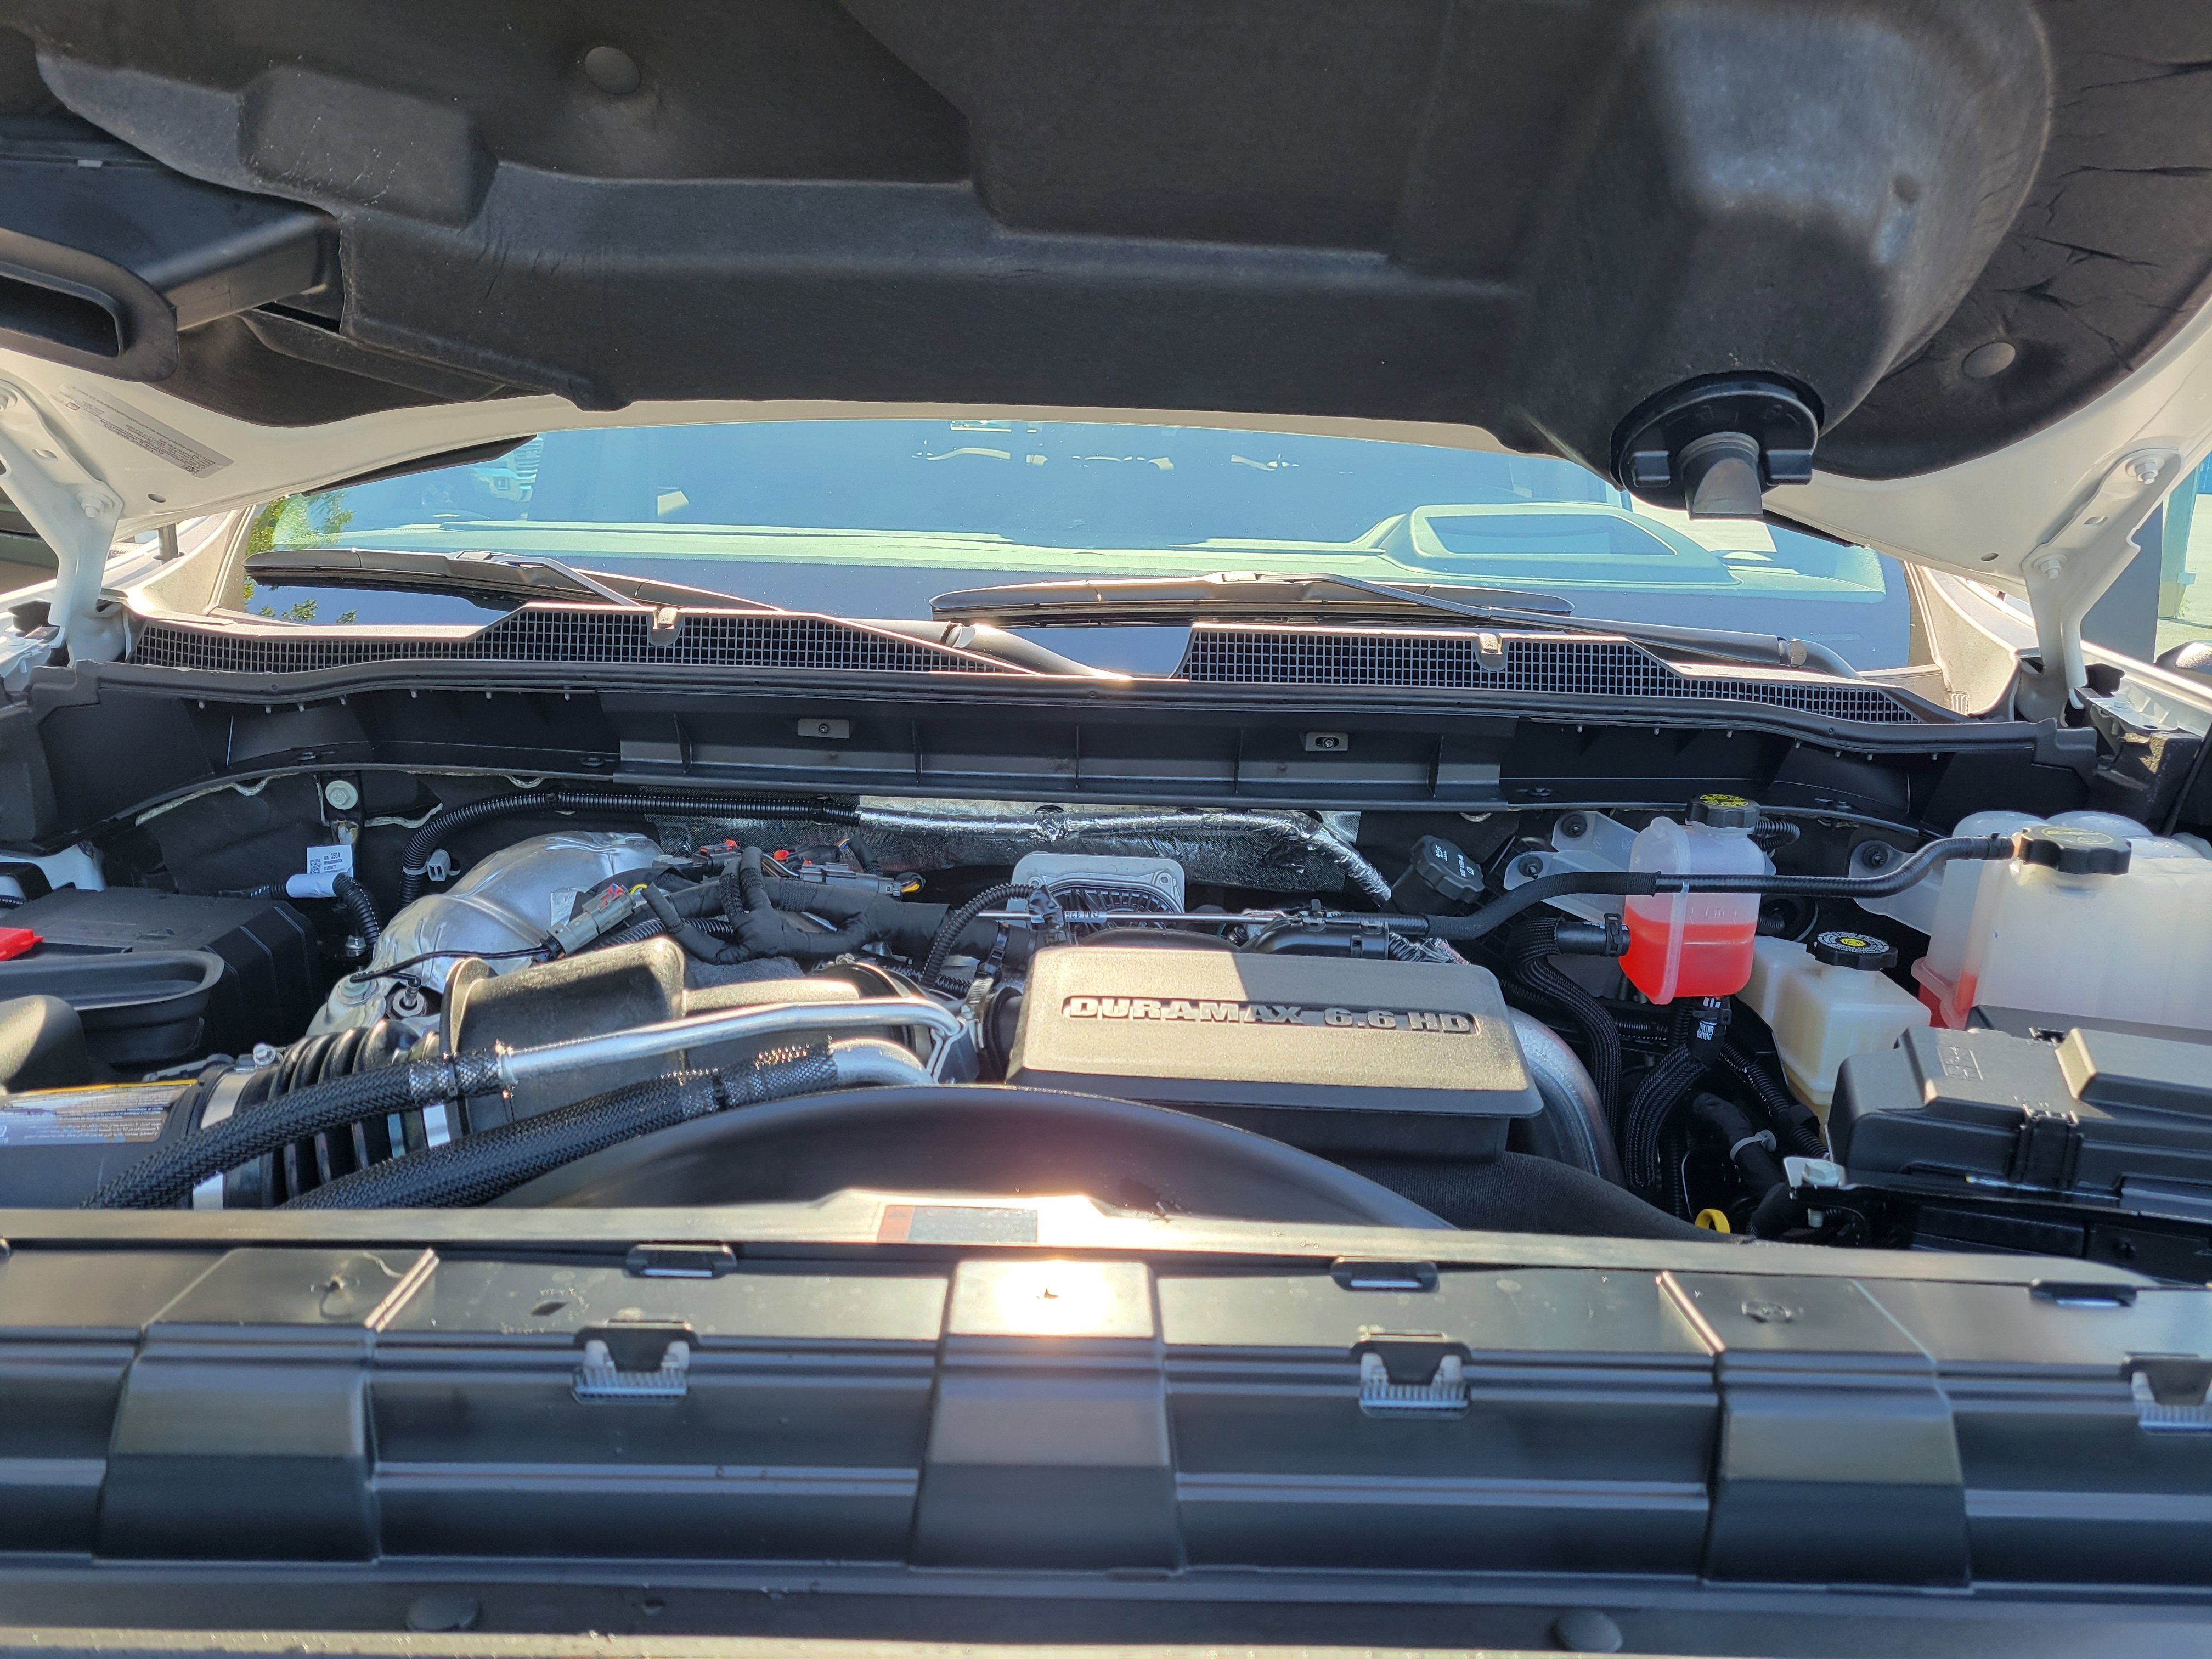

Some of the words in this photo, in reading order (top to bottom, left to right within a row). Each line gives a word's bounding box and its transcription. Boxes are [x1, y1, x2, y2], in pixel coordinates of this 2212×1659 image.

[1069, 997, 1305, 1025] DURAMAX
[1324, 1007, 1397, 1029] 6.6
[1409, 1011, 1472, 1034] HD
